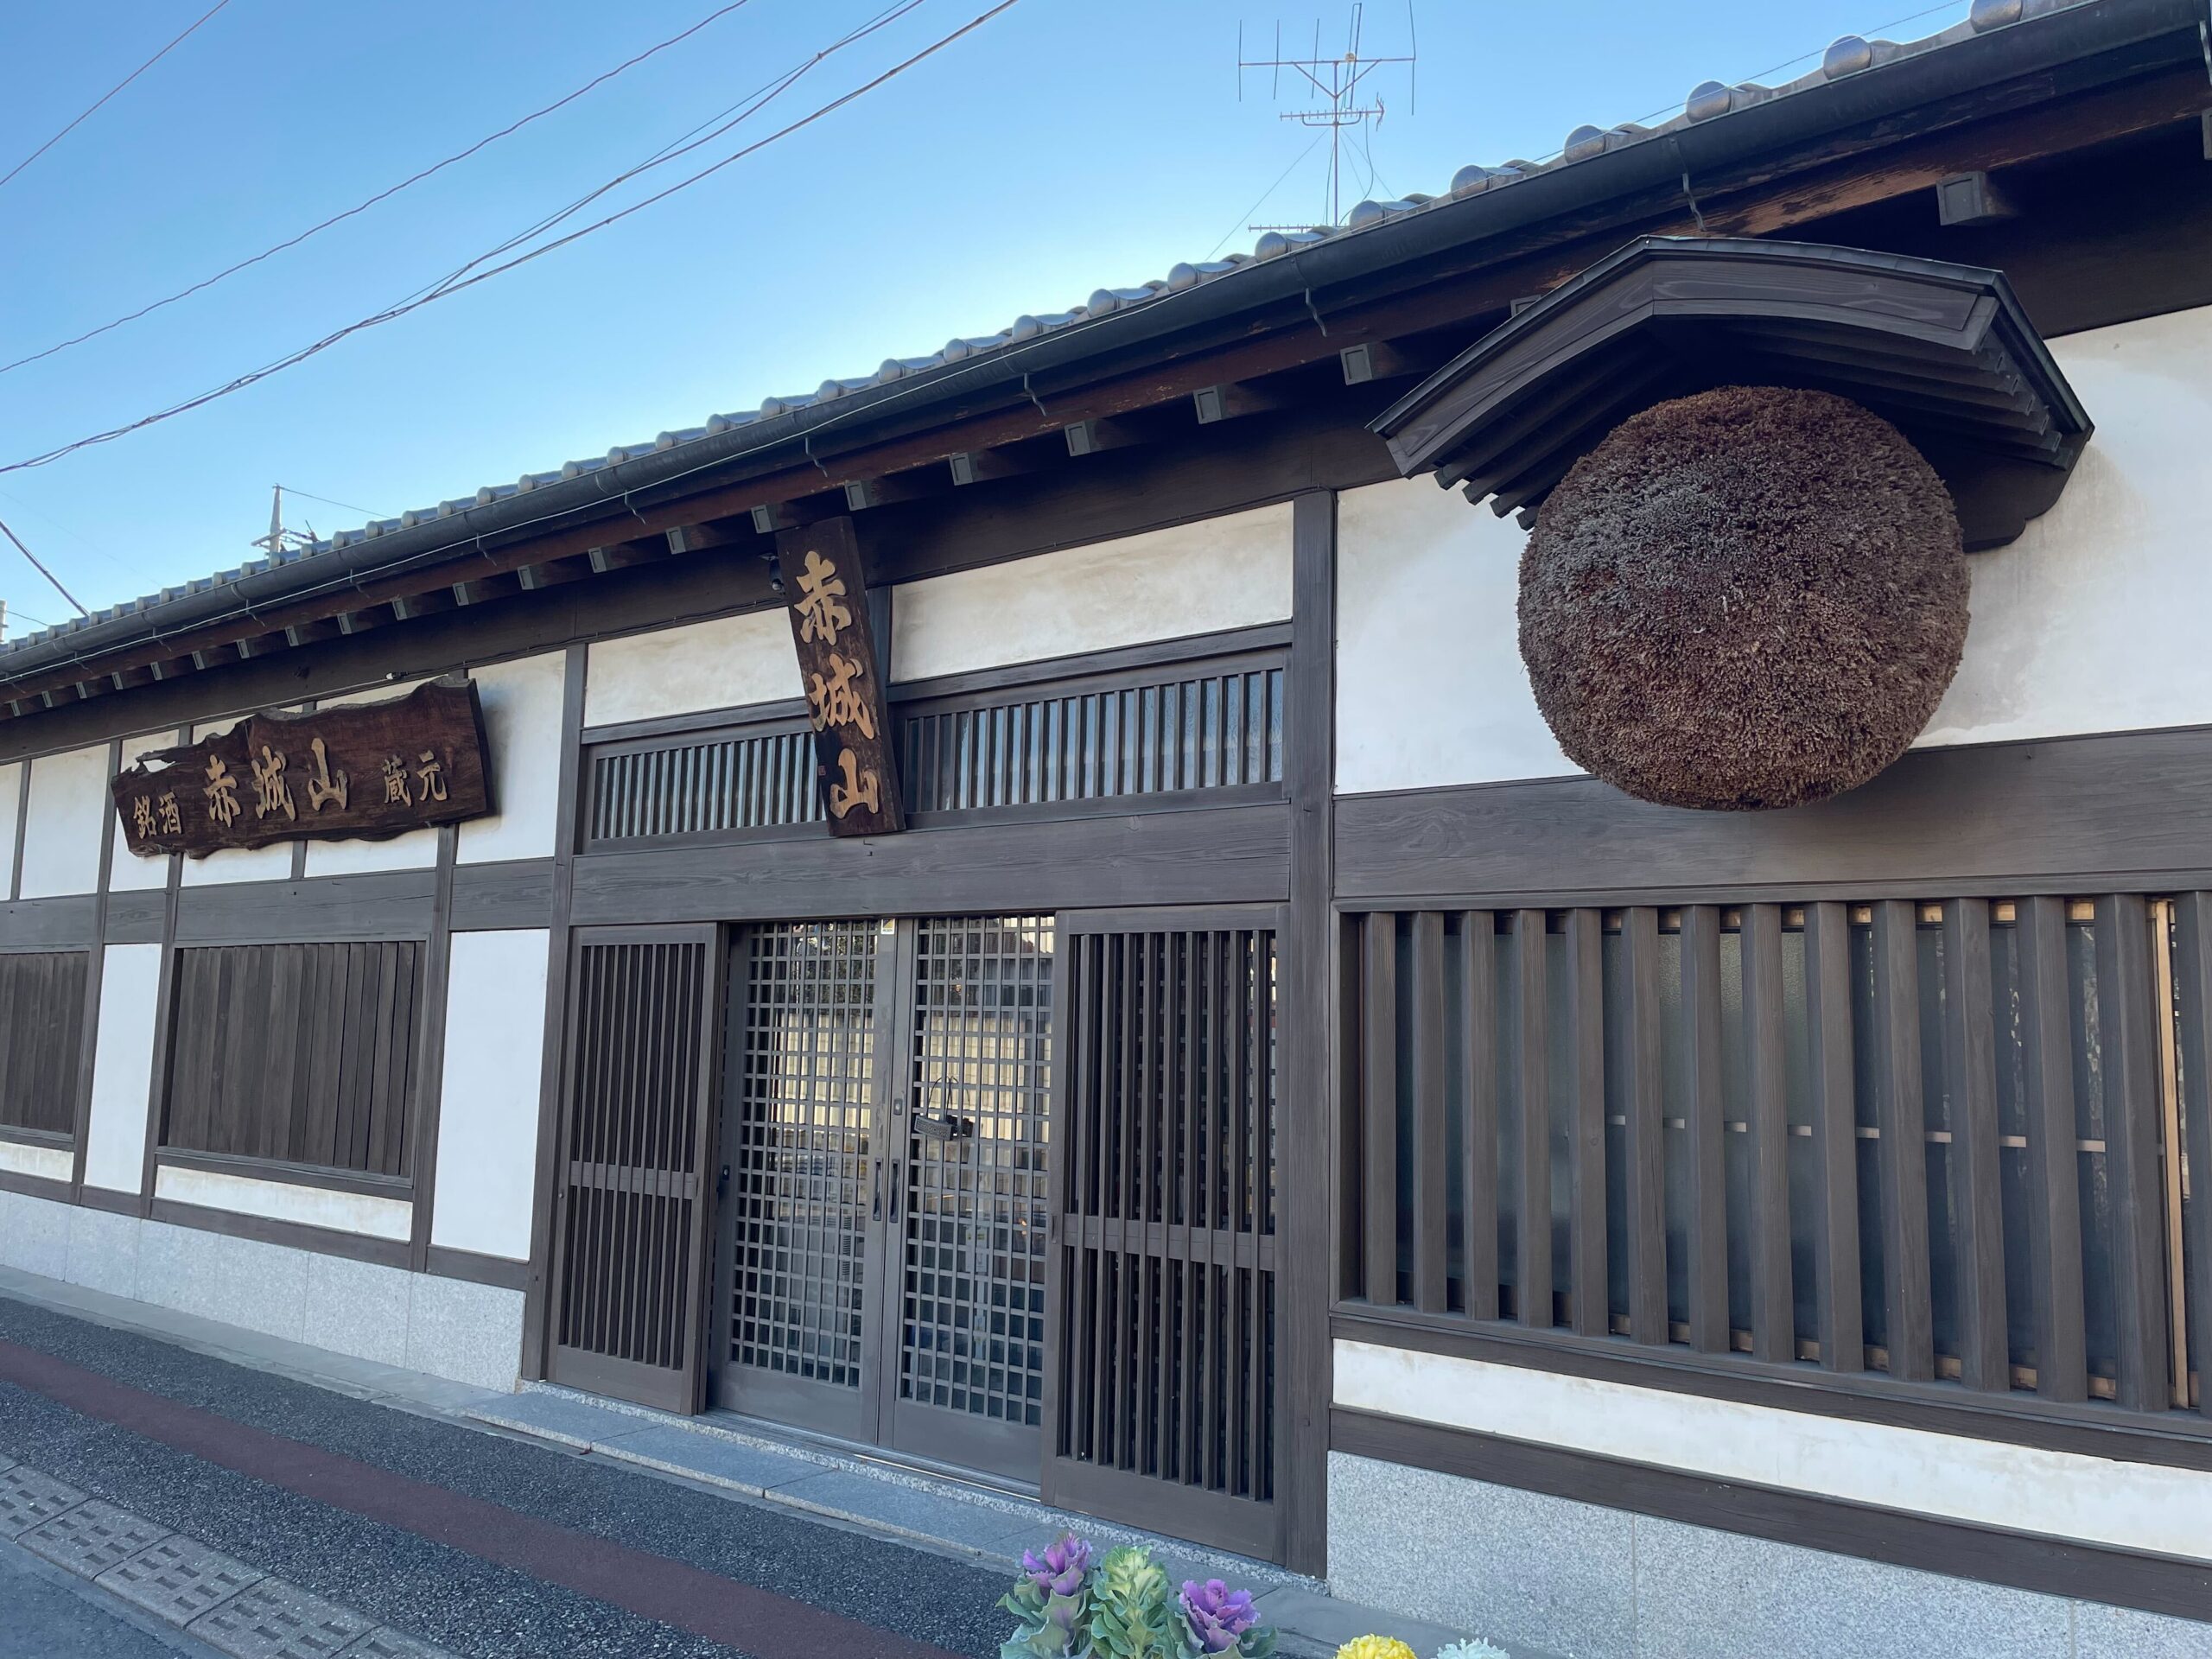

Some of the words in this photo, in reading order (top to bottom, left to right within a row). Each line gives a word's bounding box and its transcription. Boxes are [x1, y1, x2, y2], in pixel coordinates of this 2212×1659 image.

[794, 550, 879, 819] 赤城山
[133, 791, 181, 839] 銘酒
[203, 738, 347, 827] 赤城山
[382, 750, 448, 807] 蔵元
